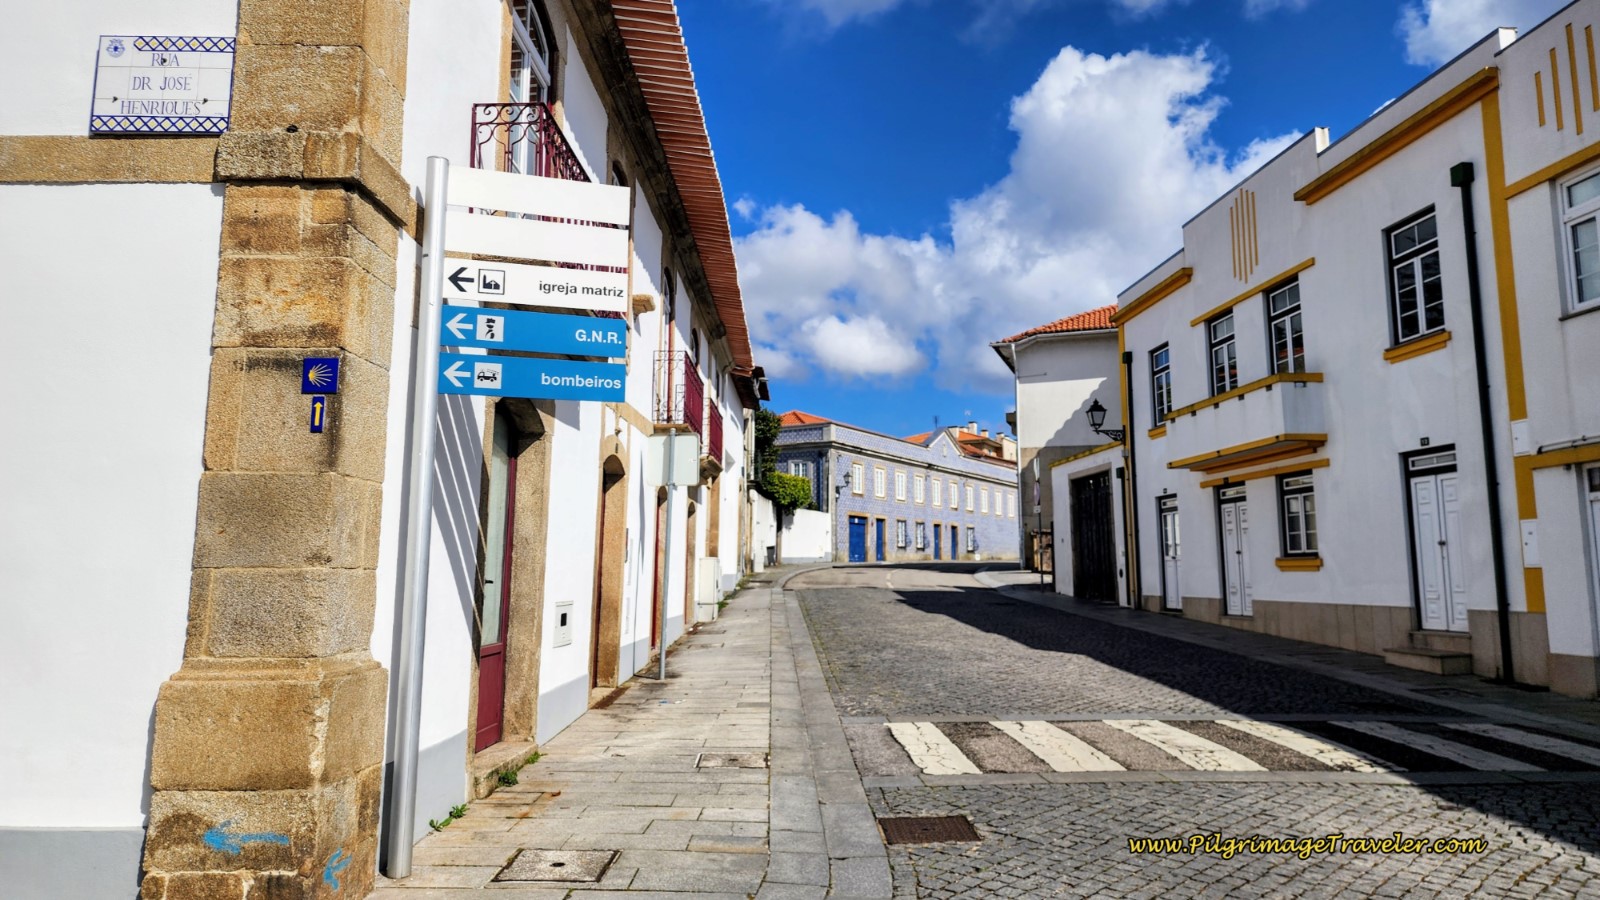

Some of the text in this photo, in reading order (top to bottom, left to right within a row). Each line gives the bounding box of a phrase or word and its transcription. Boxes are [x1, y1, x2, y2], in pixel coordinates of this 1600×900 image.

[151, 52, 180, 67] RUA
[132, 76, 153, 91] DR
[120, 100, 201, 115] HENRIQUES
[539, 280, 624, 298] igreja matriz
[575, 329, 622, 345] G.N.R.
[541, 372, 622, 389] bombeiros
